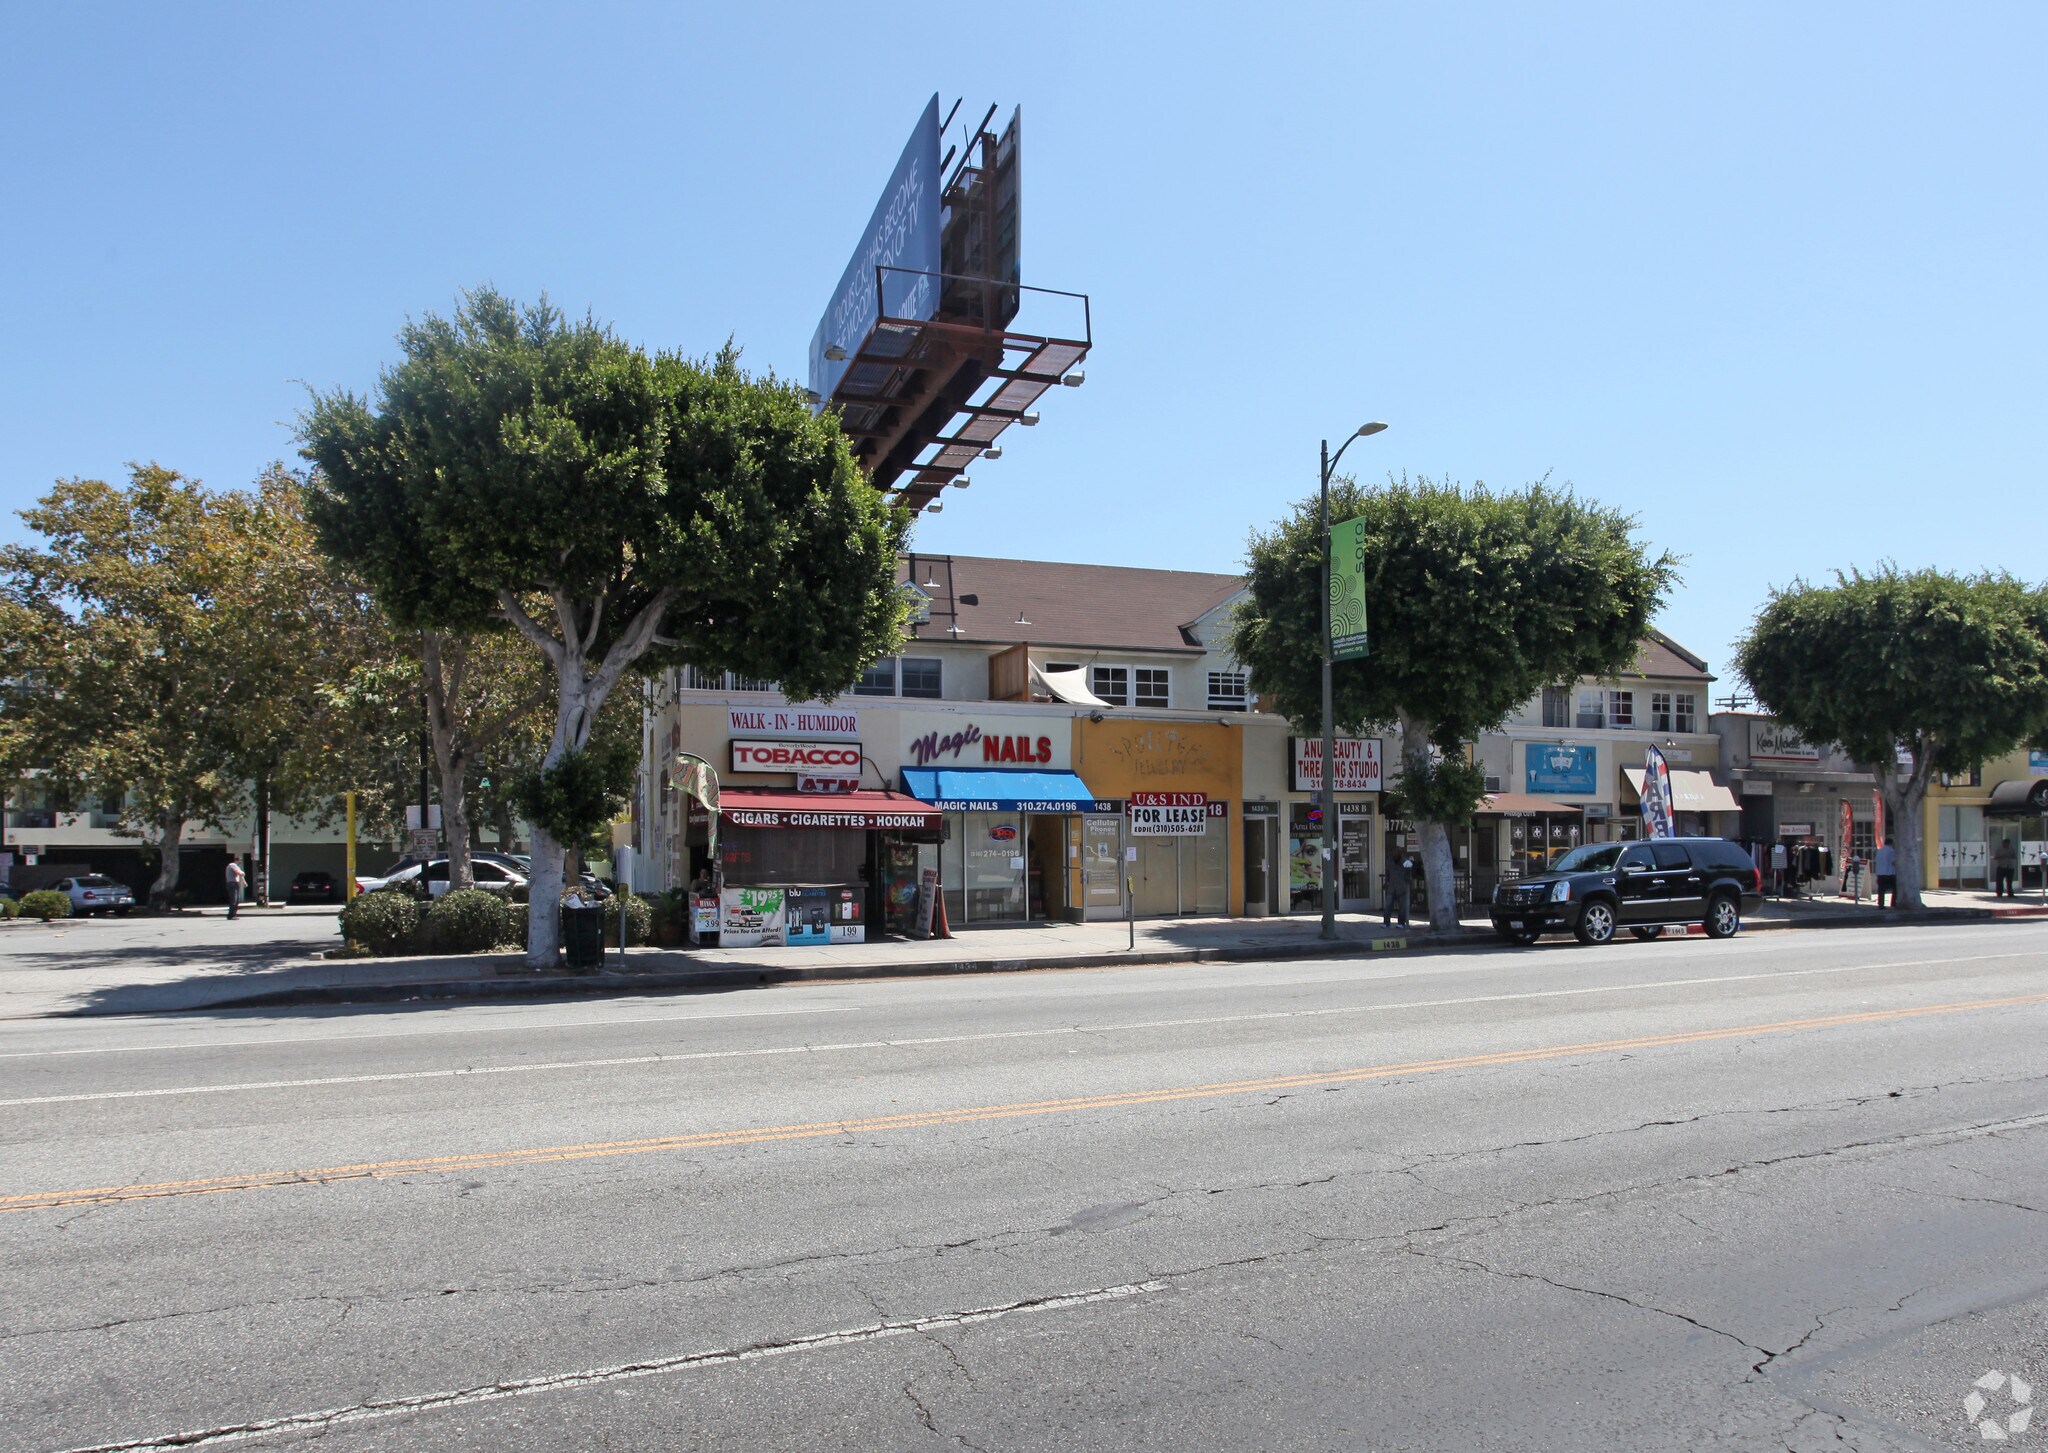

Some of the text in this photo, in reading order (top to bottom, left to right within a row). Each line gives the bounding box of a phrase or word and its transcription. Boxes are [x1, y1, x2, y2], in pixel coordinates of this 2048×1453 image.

[884, 157, 918, 244] BECOME
[731, 712, 765, 730] WALK
[775, 713, 788, 730] IN
[798, 714, 857, 732] HUMIDOR
[911, 723, 1052, 766] Magic NAILS
[1304, 741, 1373, 758] ANU EAUTY &
[735, 746, 860, 765] TOBACCO
[1298, 761, 1379, 779] THREANG STUDIO
[801, 779, 859, 791] ATM
[935, 802, 1076, 811] MAGIC NAILS 310.274.0196
[1136, 794, 1203, 805] U&S IND
[1094, 803, 1111, 811] 1438
[732, 812, 925, 827] CIGARS CIGARETTES HOOKAH
[1135, 809, 1160, 822] FOR
[1166, 809, 1204, 822] LEASE
[990, 828, 1016, 840] OPEN
[789, 888, 801, 897] blu
